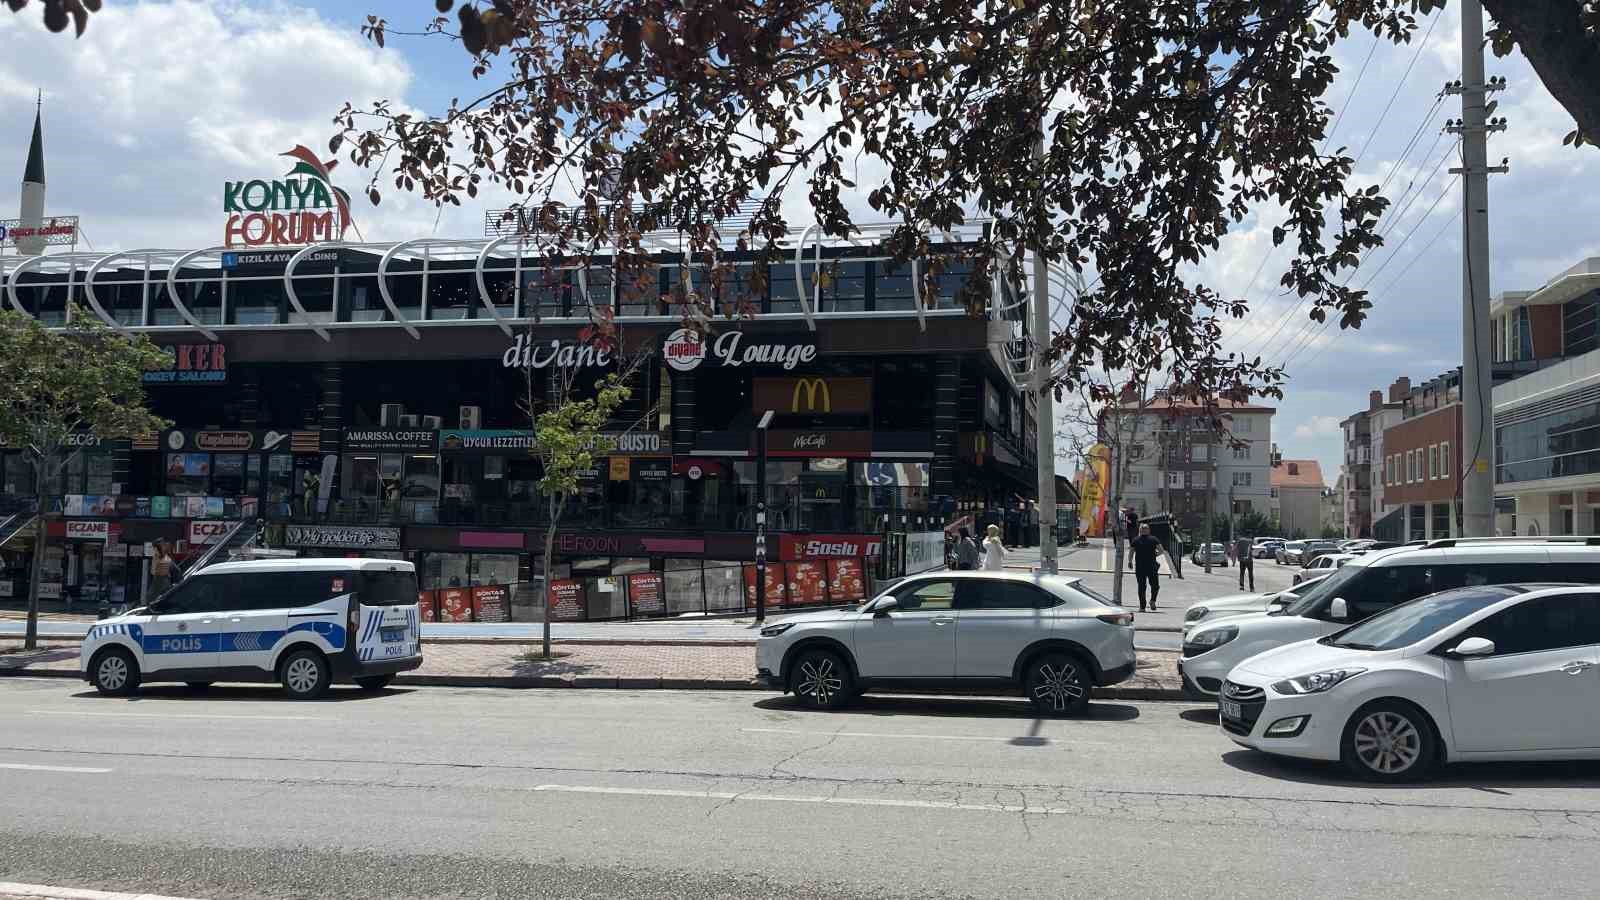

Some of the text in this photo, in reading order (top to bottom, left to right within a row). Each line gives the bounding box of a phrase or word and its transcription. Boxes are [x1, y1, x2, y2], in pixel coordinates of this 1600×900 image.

[224, 178, 333, 212] KONYA
[224, 211, 334, 248] FORUM
[713, 331, 817, 370] Lounge
[347, 431, 433, 441] AMARISSA COFFEE
[464, 437, 492, 448] UYGUR
[618, 434, 660, 451] GUSTO
[68, 523, 107, 534] ECZANE
[161, 635, 202, 652] POLİS
